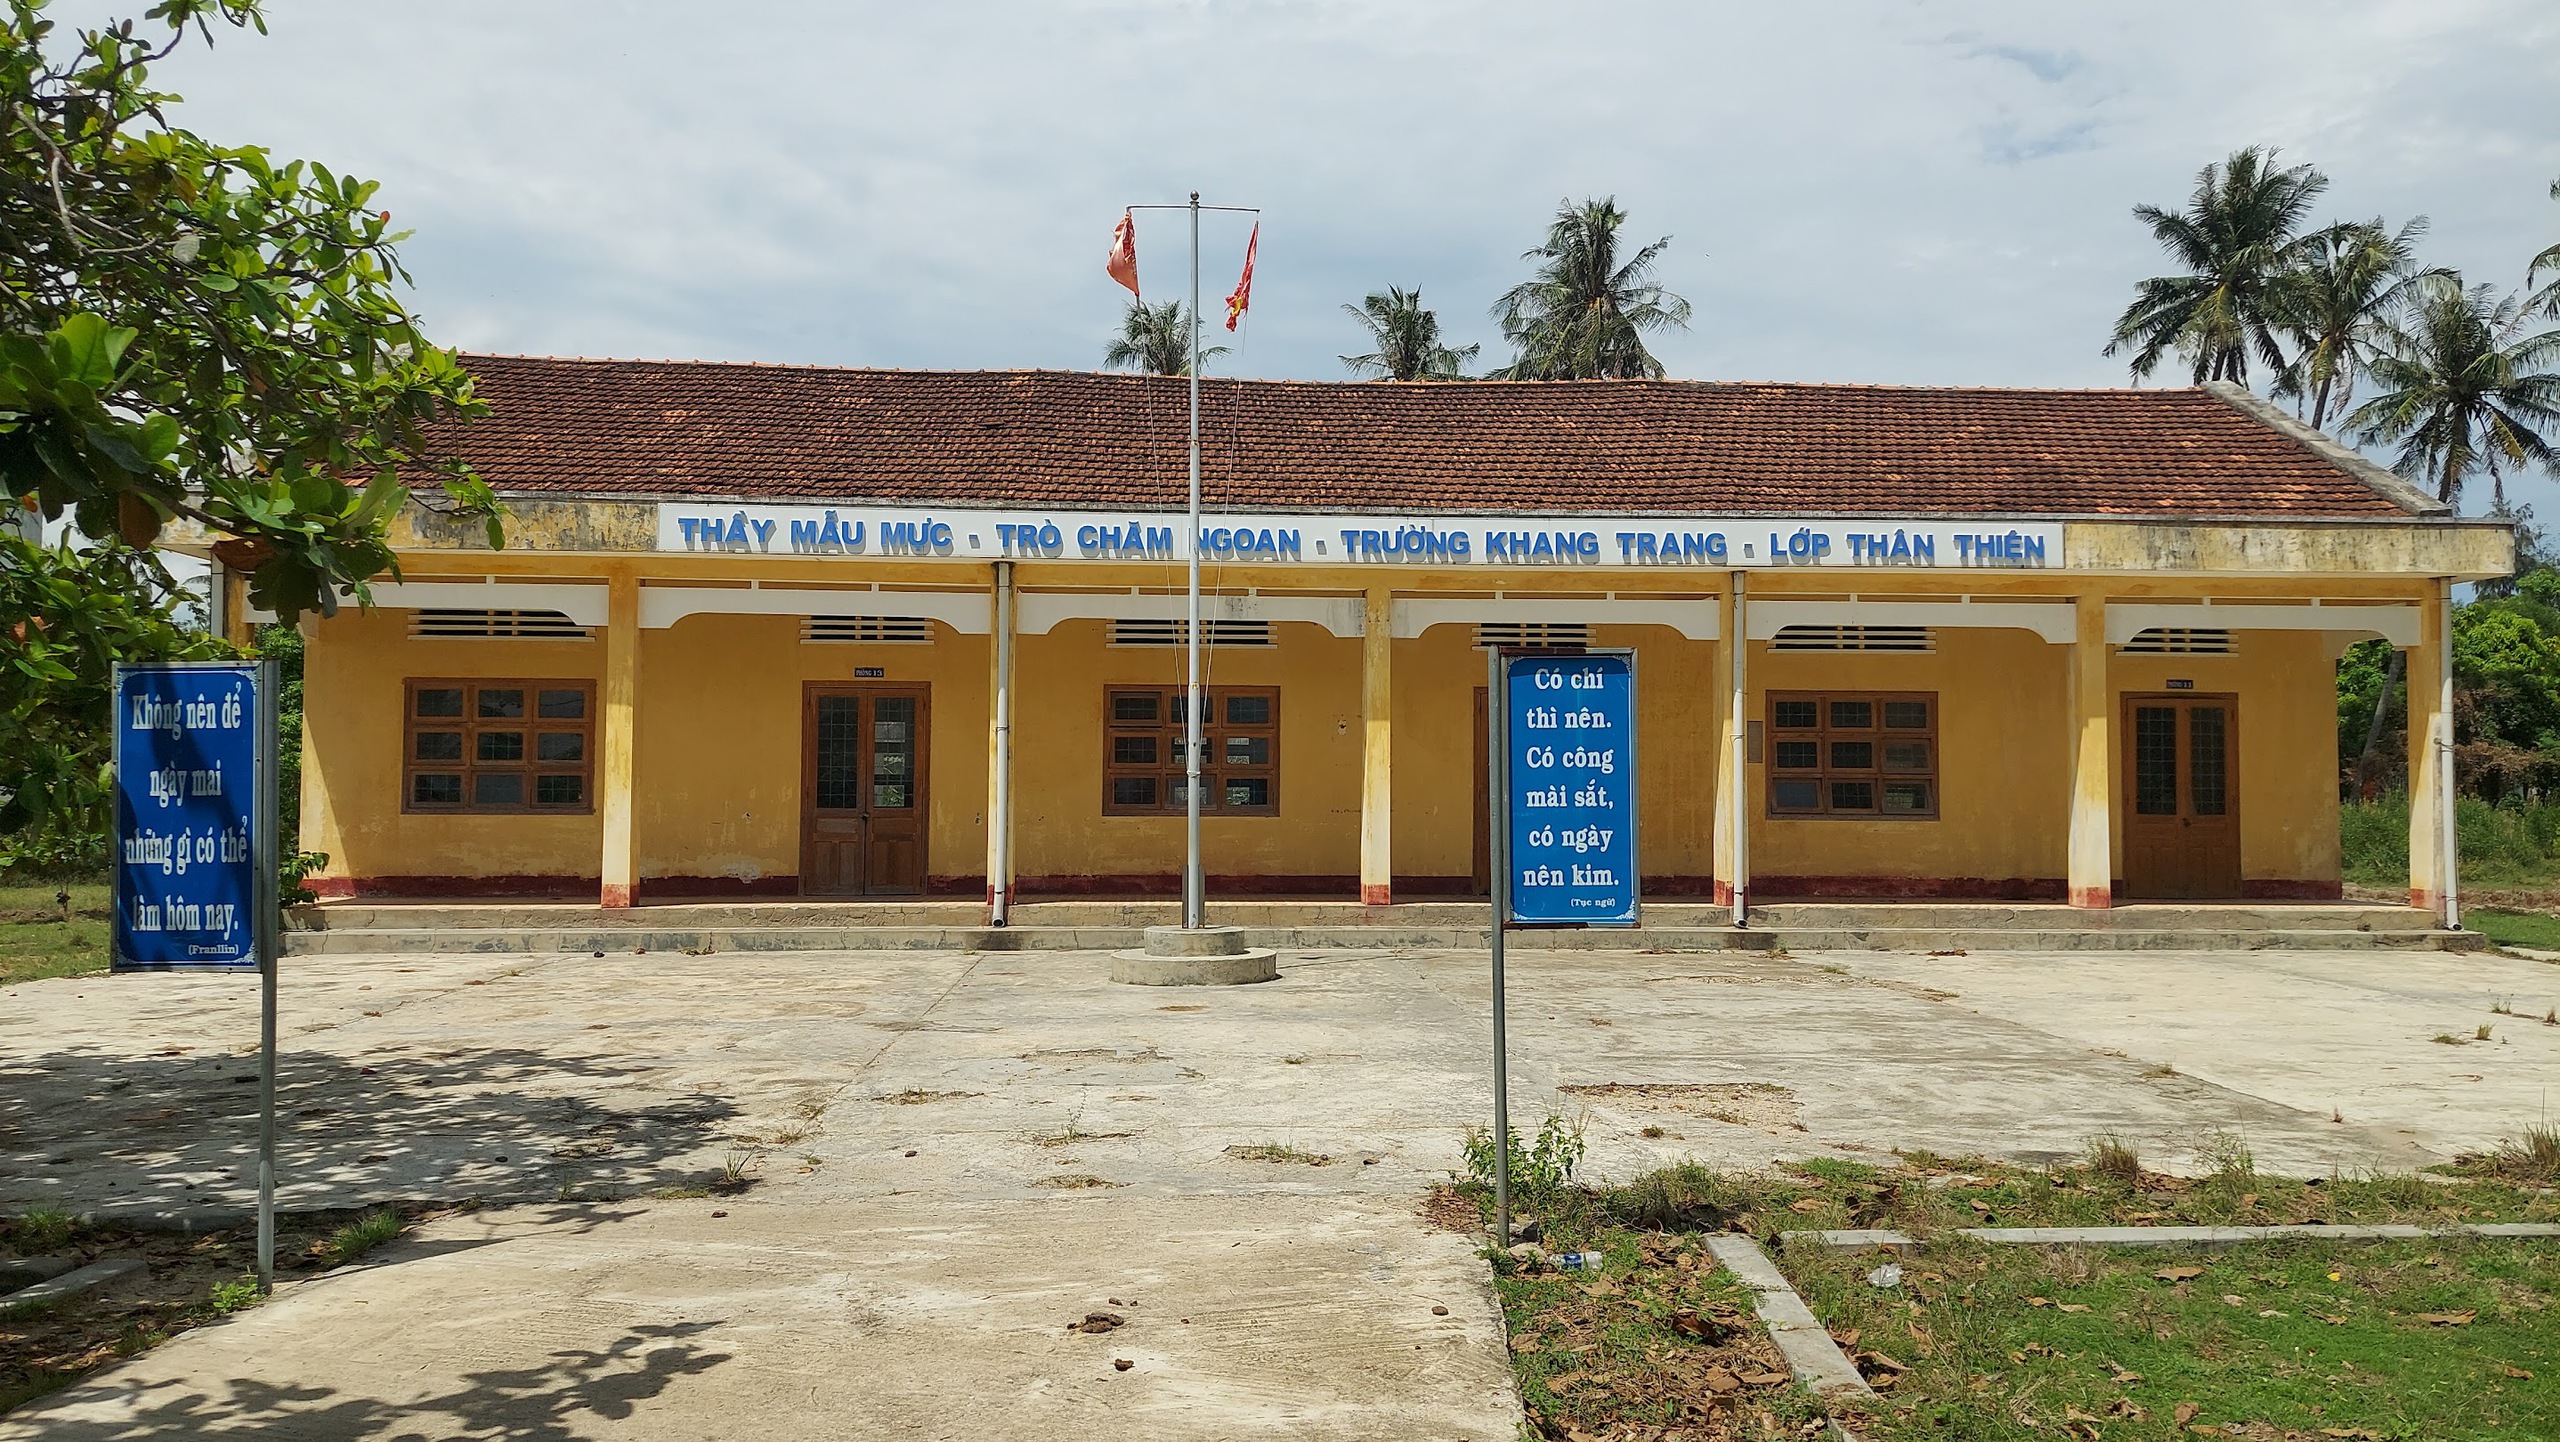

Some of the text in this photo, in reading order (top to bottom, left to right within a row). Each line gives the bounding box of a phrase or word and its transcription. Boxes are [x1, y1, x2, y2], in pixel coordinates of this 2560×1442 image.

[678, 510, 772, 542] THẦY
[791, 510, 864, 545] MẪU
[881, 518, 951, 550] MỰC
[996, 523, 1062, 548] TRÒ
[1077, 522, 1171, 550] CHĂM
[1341, 526, 1469, 554] TRƯỜNG
[1486, 532, 1599, 555] KHANG
[1616, 533, 1727, 556] TRANG
[1770, 526, 1829, 556] LỚP
[1847, 531, 1934, 557] THÂN
[1954, 532, 2044, 559] THIỆN
[1534, 667, 1604, 690] Có chí
[132, 682, 241, 740] Không nên để
[1526, 706, 1612, 729] thì nên.
[1526, 745, 1614, 774] Có công
[149, 760, 222, 808] ngày mai
[1526, 778, 1614, 810] mài sắt,
[125, 815, 248, 876] những gì có thể
[1529, 824, 1614, 853] có ngày
[1523, 863, 1619, 886] nên kim.
[132, 894, 239, 941] làm hôm nay.
[1570, 898, 1592, 908] (Tục
